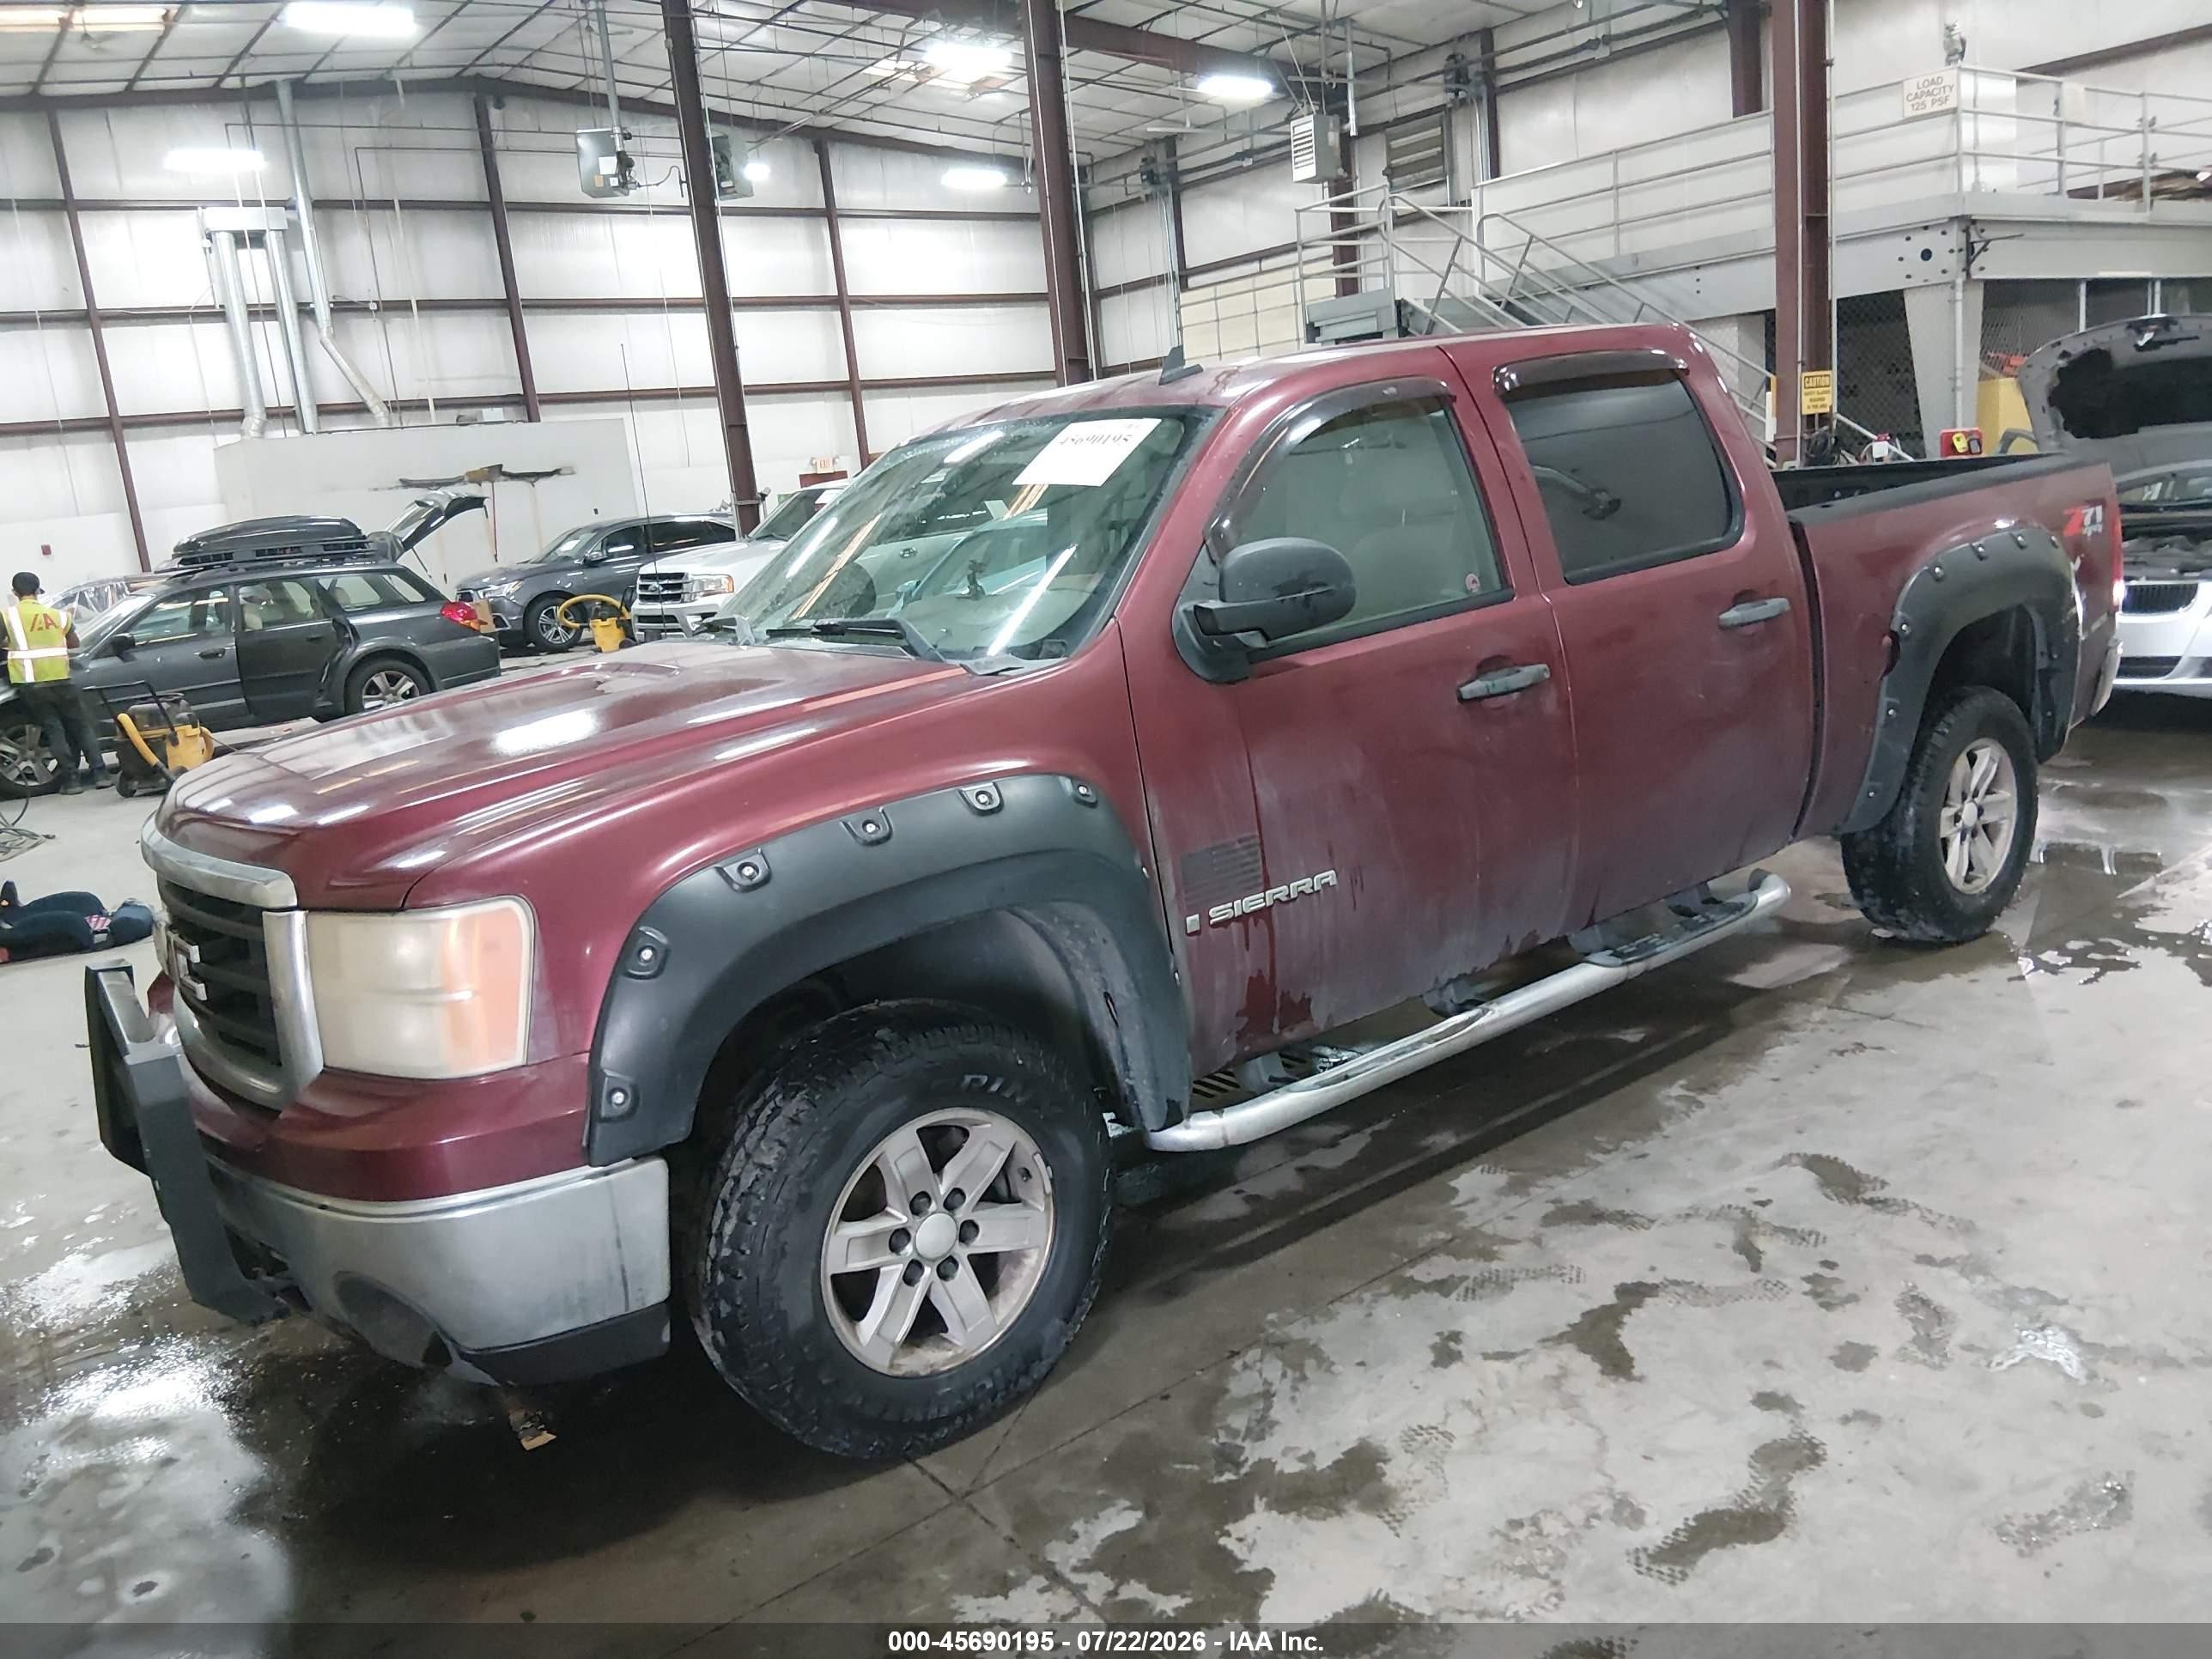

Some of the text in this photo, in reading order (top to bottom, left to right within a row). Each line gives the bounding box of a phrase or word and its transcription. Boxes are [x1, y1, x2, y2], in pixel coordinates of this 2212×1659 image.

[1916, 76, 1944, 90] LOAD
[1905, 83, 1954, 103] CAPACITY
[1911, 94, 1951, 112] 125 PSF
[1804, 375, 1831, 388] CAUTION
[2063, 504, 2103, 537] Z71
[1207, 869, 1340, 926] SIERRA
